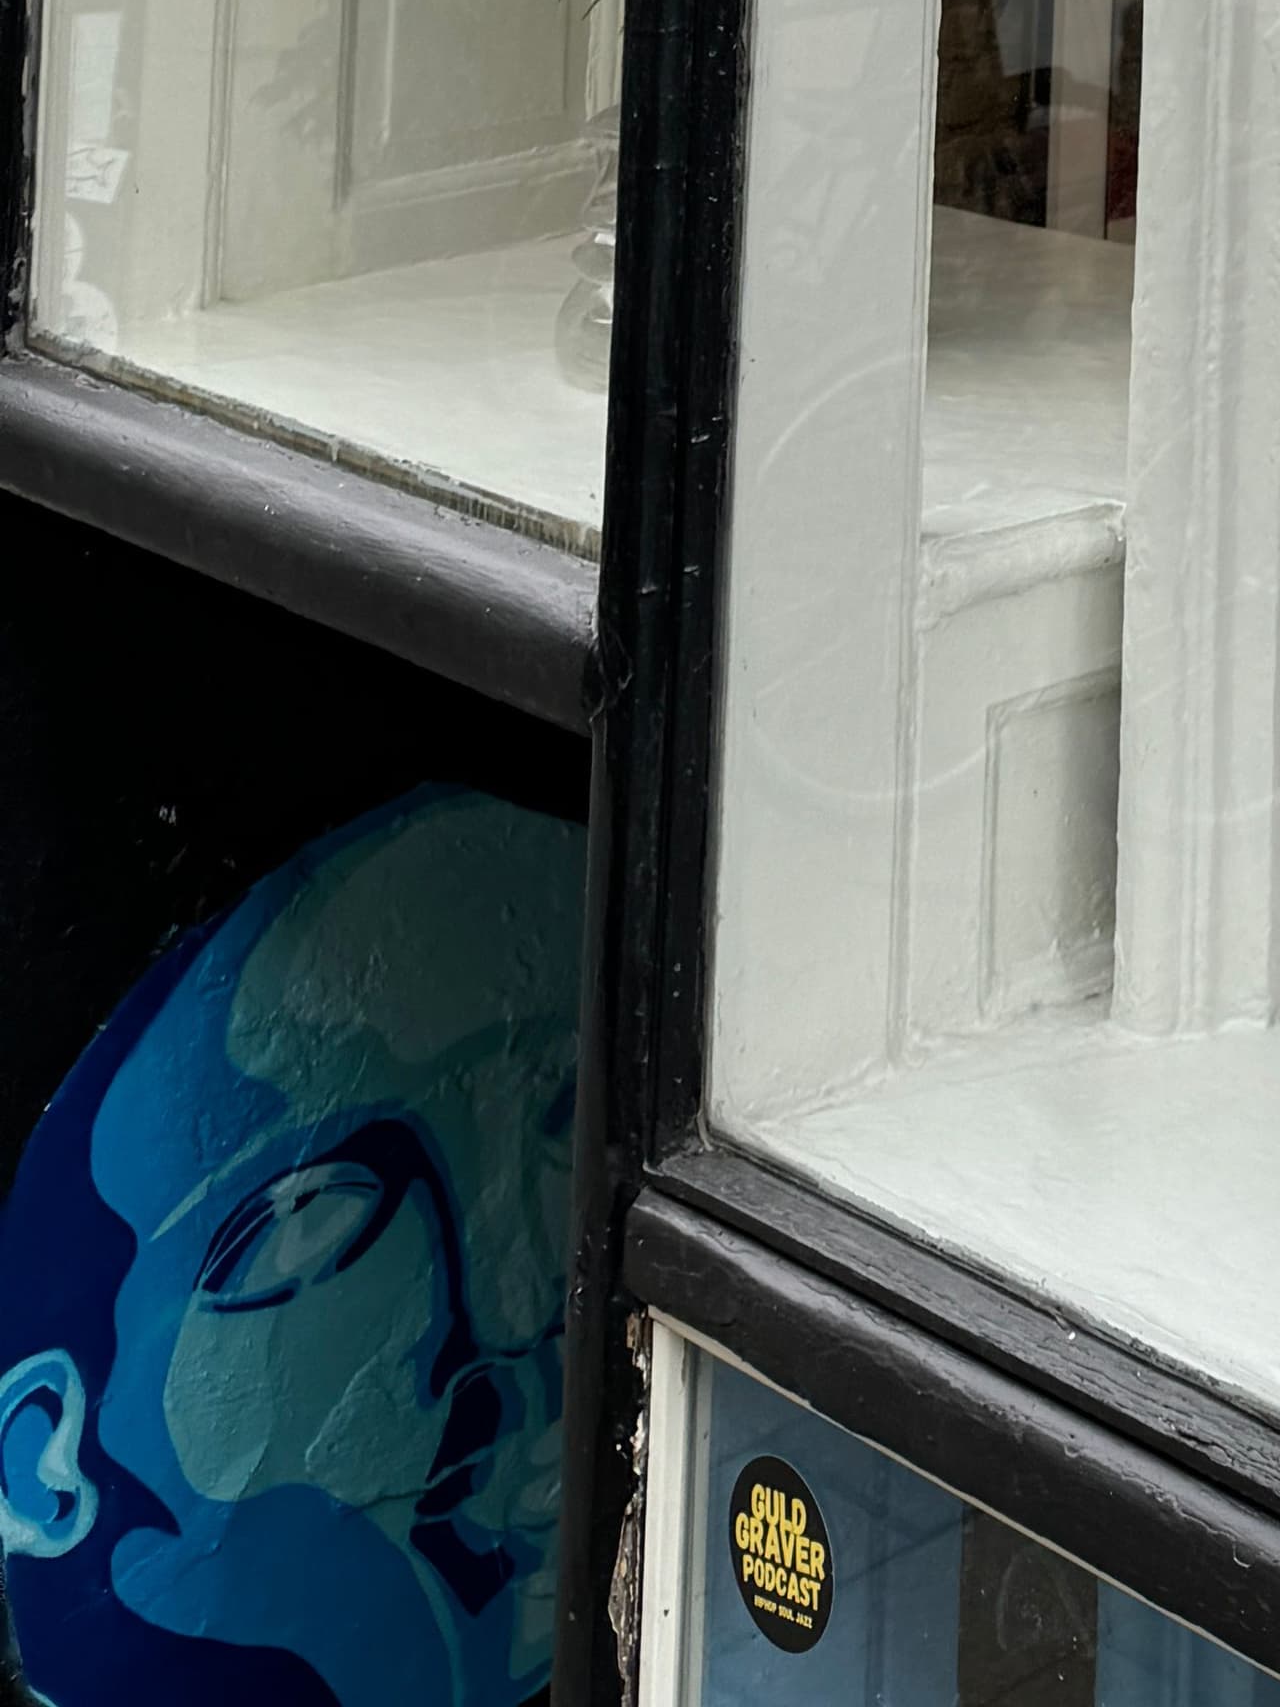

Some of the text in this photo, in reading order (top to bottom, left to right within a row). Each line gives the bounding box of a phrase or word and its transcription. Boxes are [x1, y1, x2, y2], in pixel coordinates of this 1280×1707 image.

[751, 1483, 807, 1536] GULD
[735, 1512, 825, 1580] GRAVER
[742, 1554, 821, 1611] PODCAST
